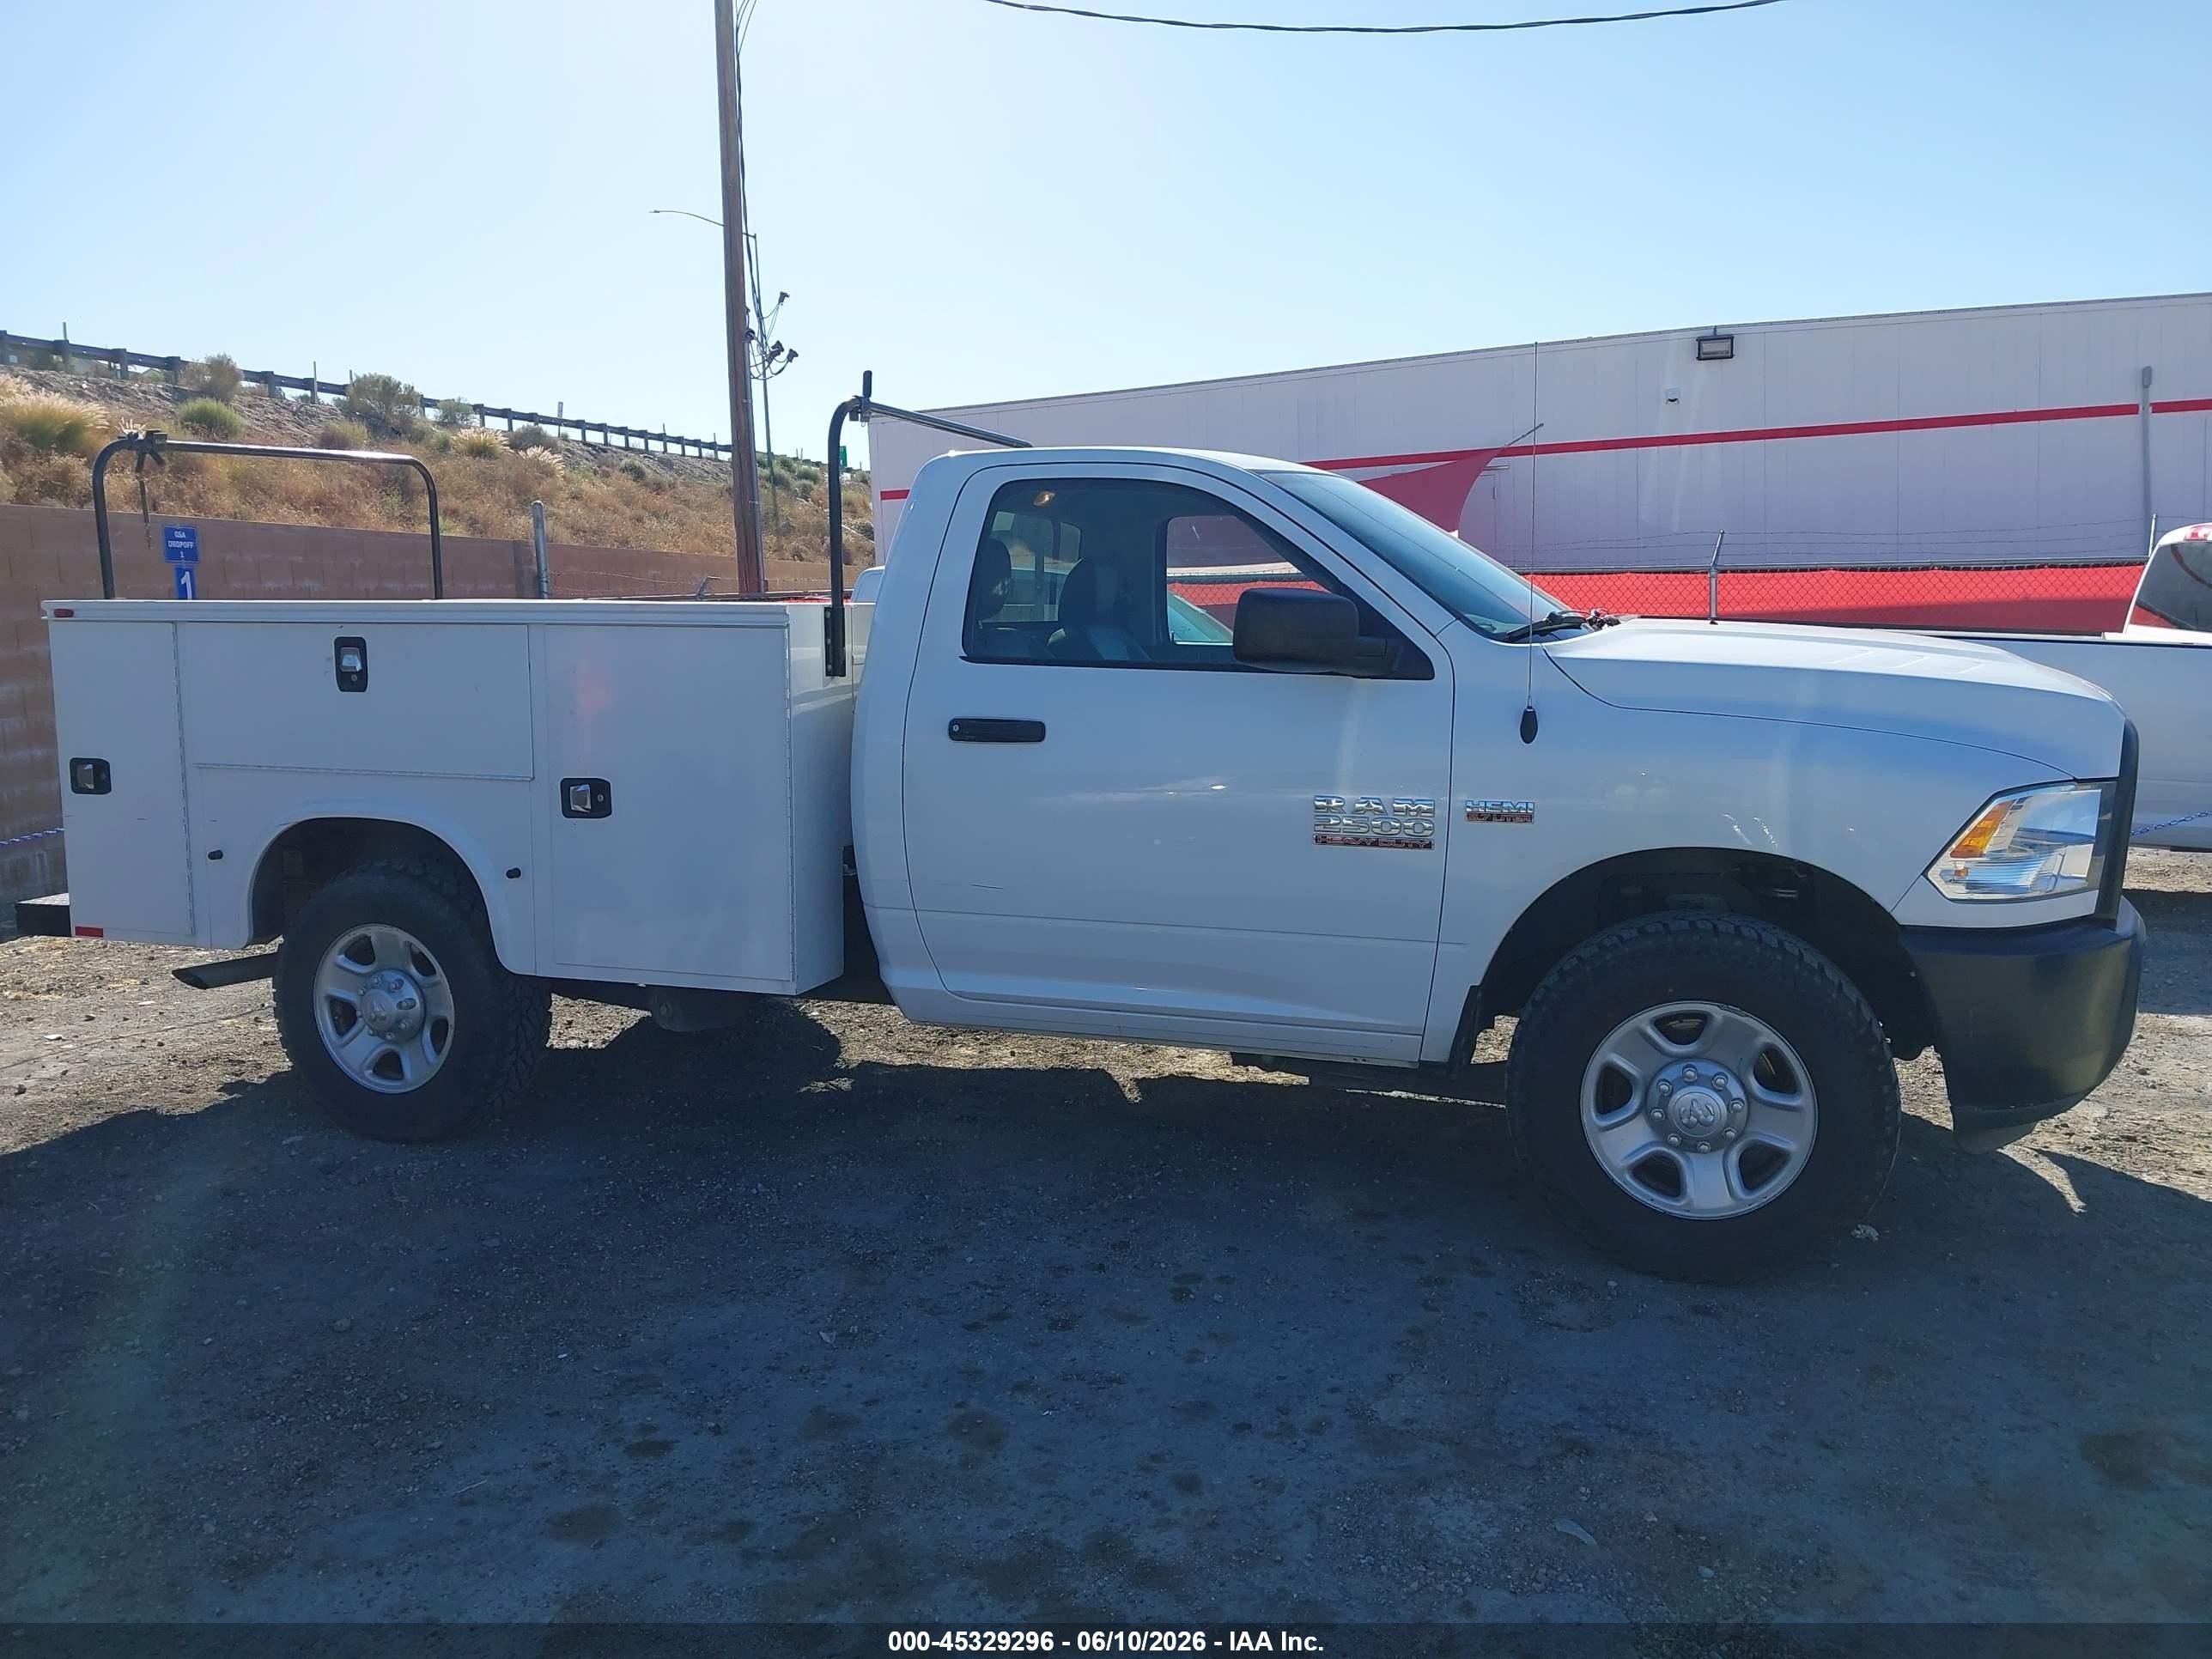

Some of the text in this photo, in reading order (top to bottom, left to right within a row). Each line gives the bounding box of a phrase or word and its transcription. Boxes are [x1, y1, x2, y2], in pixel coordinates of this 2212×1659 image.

[167, 540, 194, 549] DROPOFF
[180, 571, 192, 599] 1
[1314, 795, 1436, 817] RAM
[1466, 800, 1534, 813] HEMI
[1314, 815, 1435, 837] 2500
[1316, 836, 1430, 848] HEAVY DUTY
